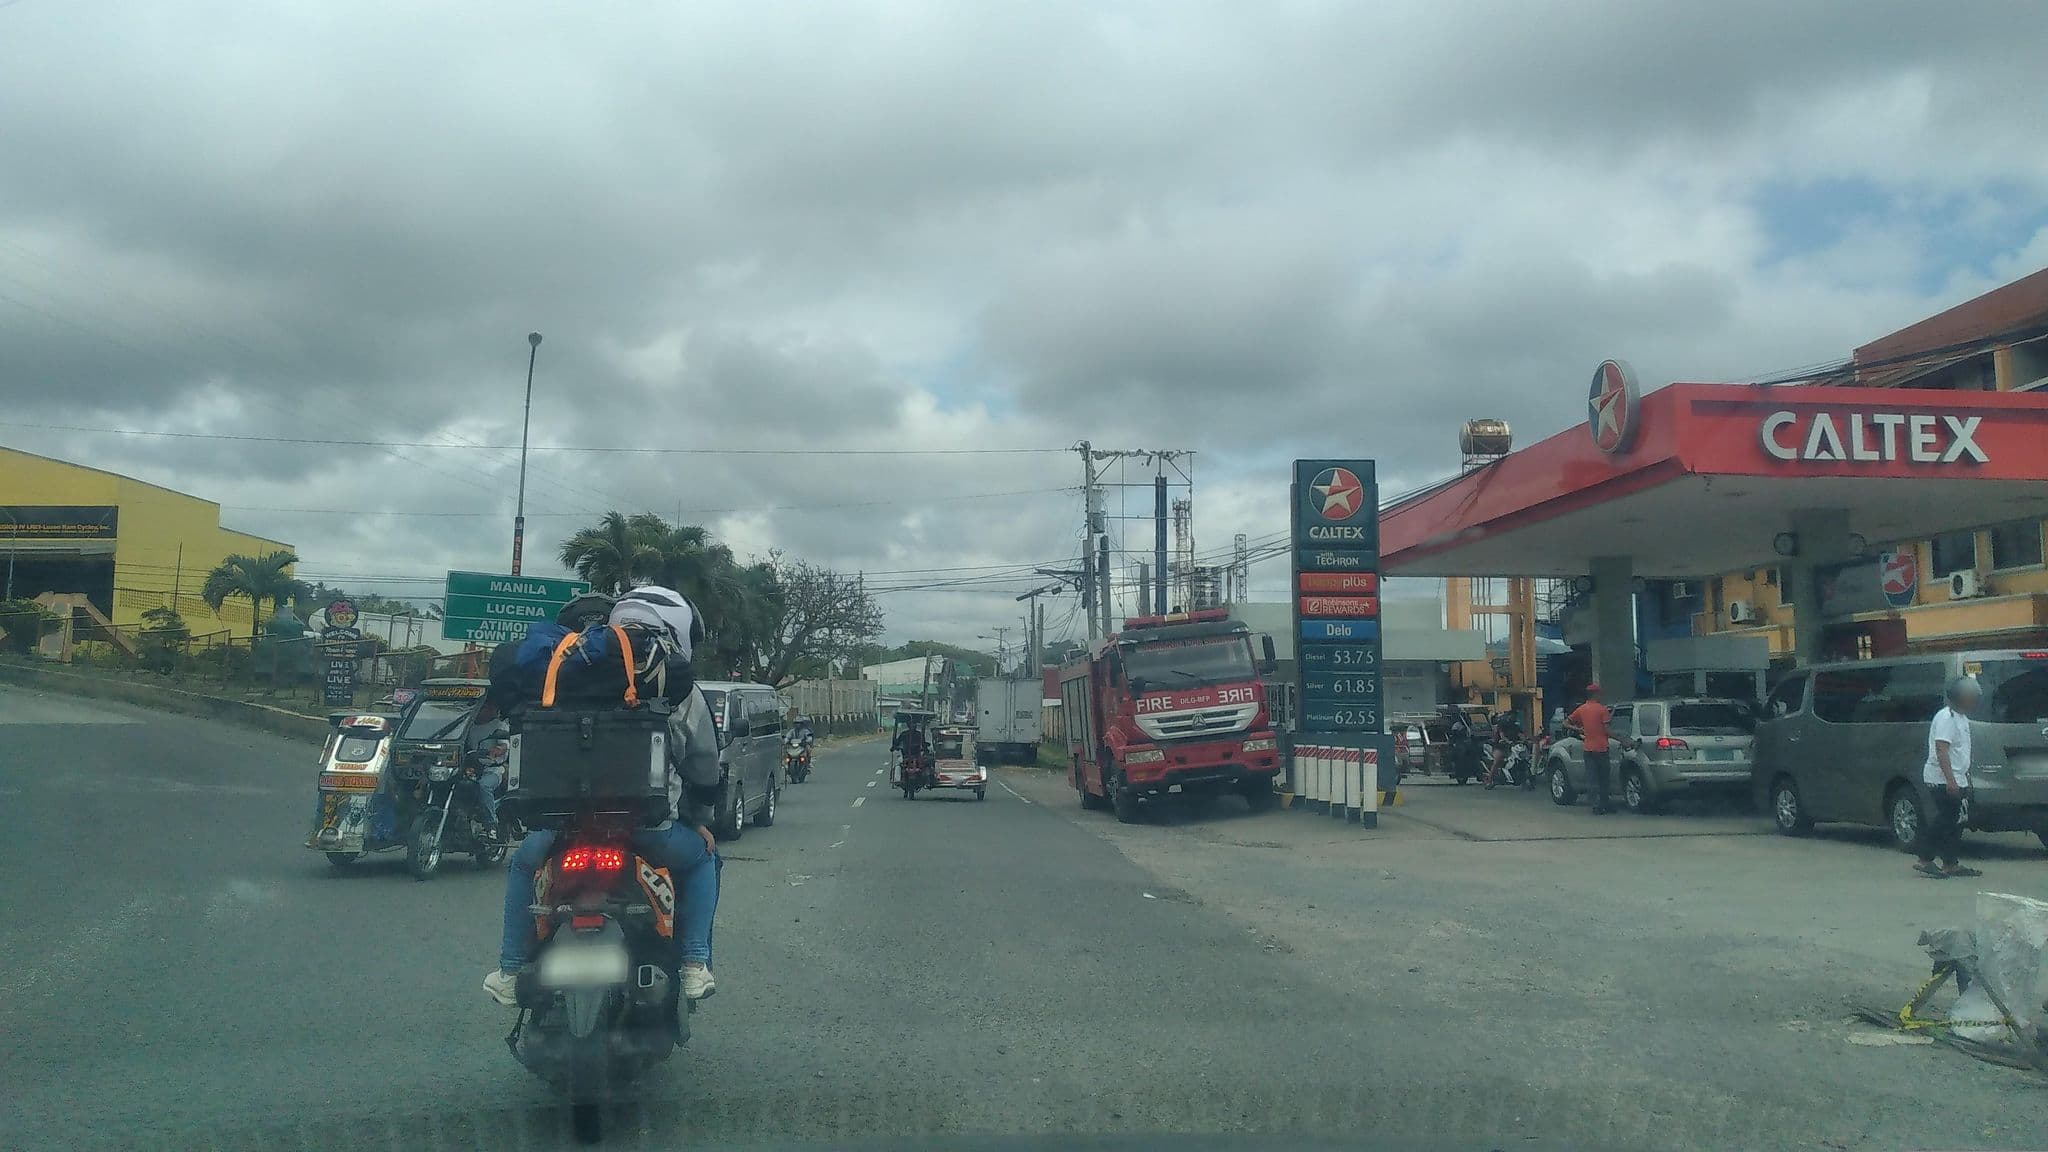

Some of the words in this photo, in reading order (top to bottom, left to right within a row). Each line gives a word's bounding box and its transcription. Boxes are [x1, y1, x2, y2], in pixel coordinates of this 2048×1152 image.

[1762, 411, 1990, 463] CALTEX
[1309, 526, 1365, 540] CALTEX
[1315, 555, 1359, 568] TECHRON
[490, 581, 547, 596] MANILA
[486, 603, 545, 617] LUCENA
[1322, 605, 1364, 614] REWARDS
[480, 620, 529, 633] ATIMON
[1326, 623, 1351, 636] Delo
[466, 629, 506, 641] TOWN
[1333, 650, 1374, 664] 53.75
[327, 676, 351, 684] LIVE
[1333, 679, 1375, 693] 61.85
[1136, 696, 1173, 713] FIRE
[1334, 711, 1375, 724] 62.55
